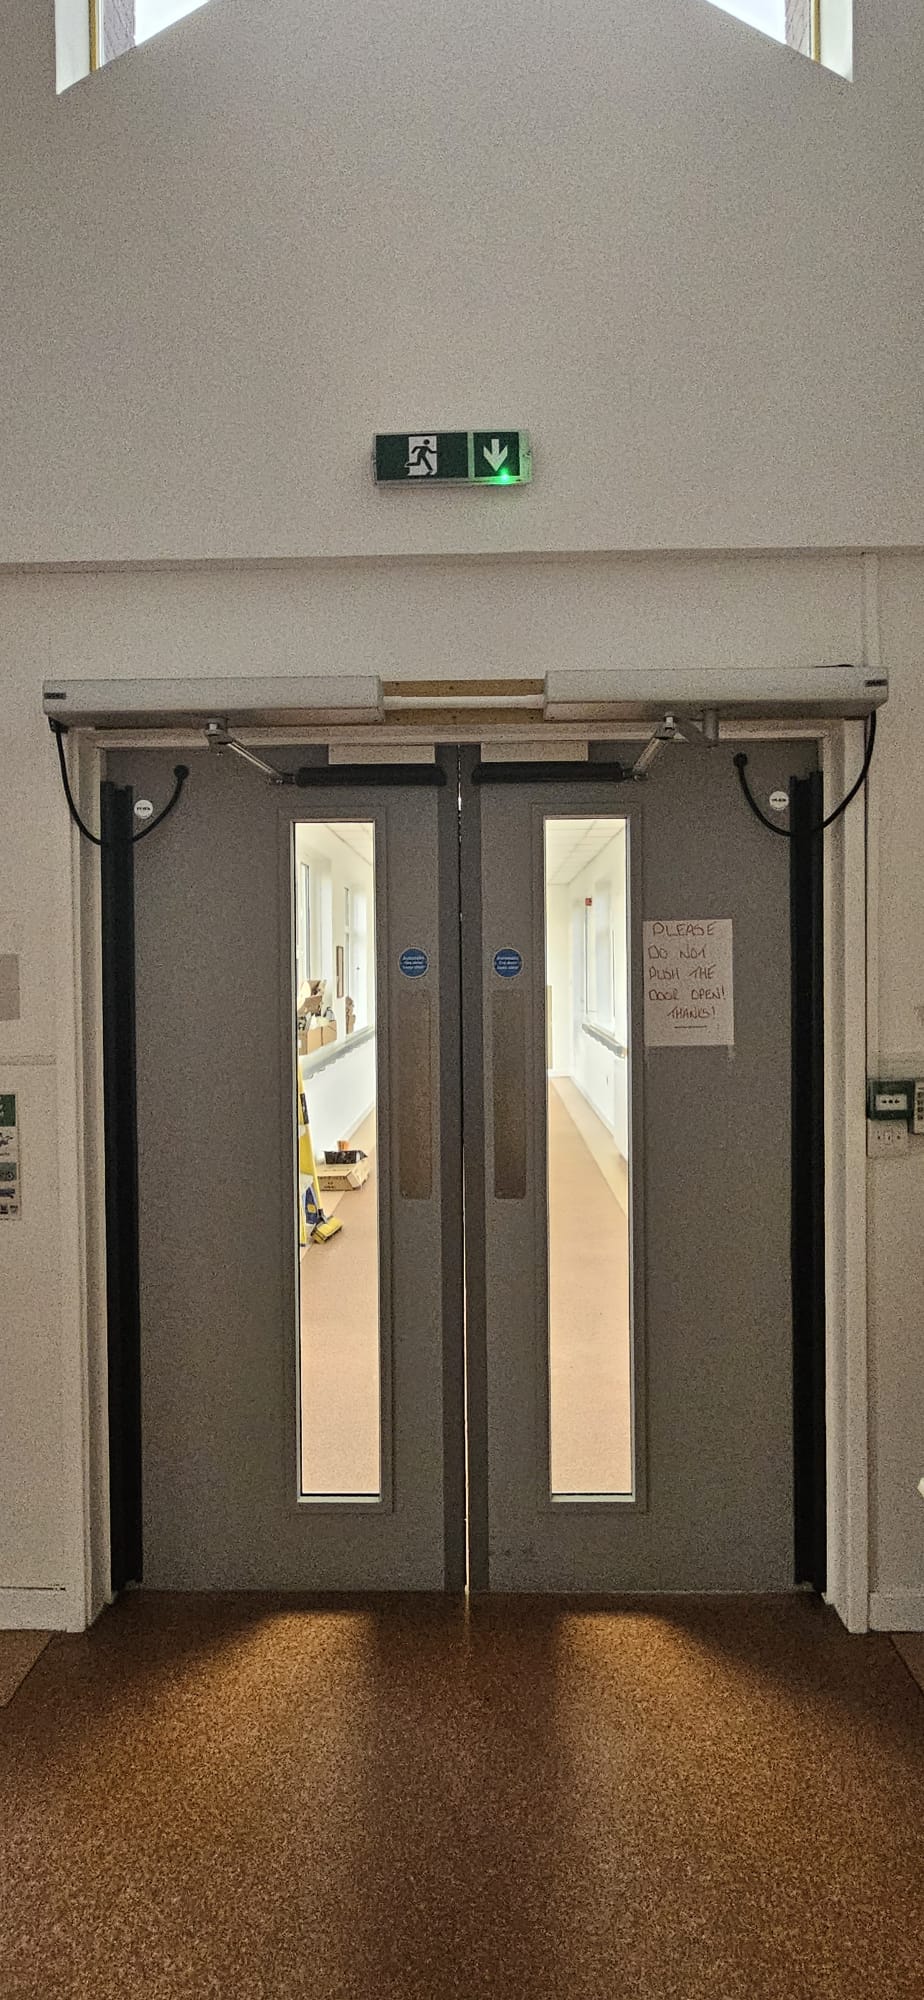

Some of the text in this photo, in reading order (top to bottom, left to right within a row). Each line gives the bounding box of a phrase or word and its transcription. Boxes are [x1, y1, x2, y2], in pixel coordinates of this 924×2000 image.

[652, 921, 717, 937] PLEASE
[648, 943, 707, 959] DO NOT
[649, 964, 717, 980] PUSH THE
[648, 984, 726, 1001] DOOR OPEN!
